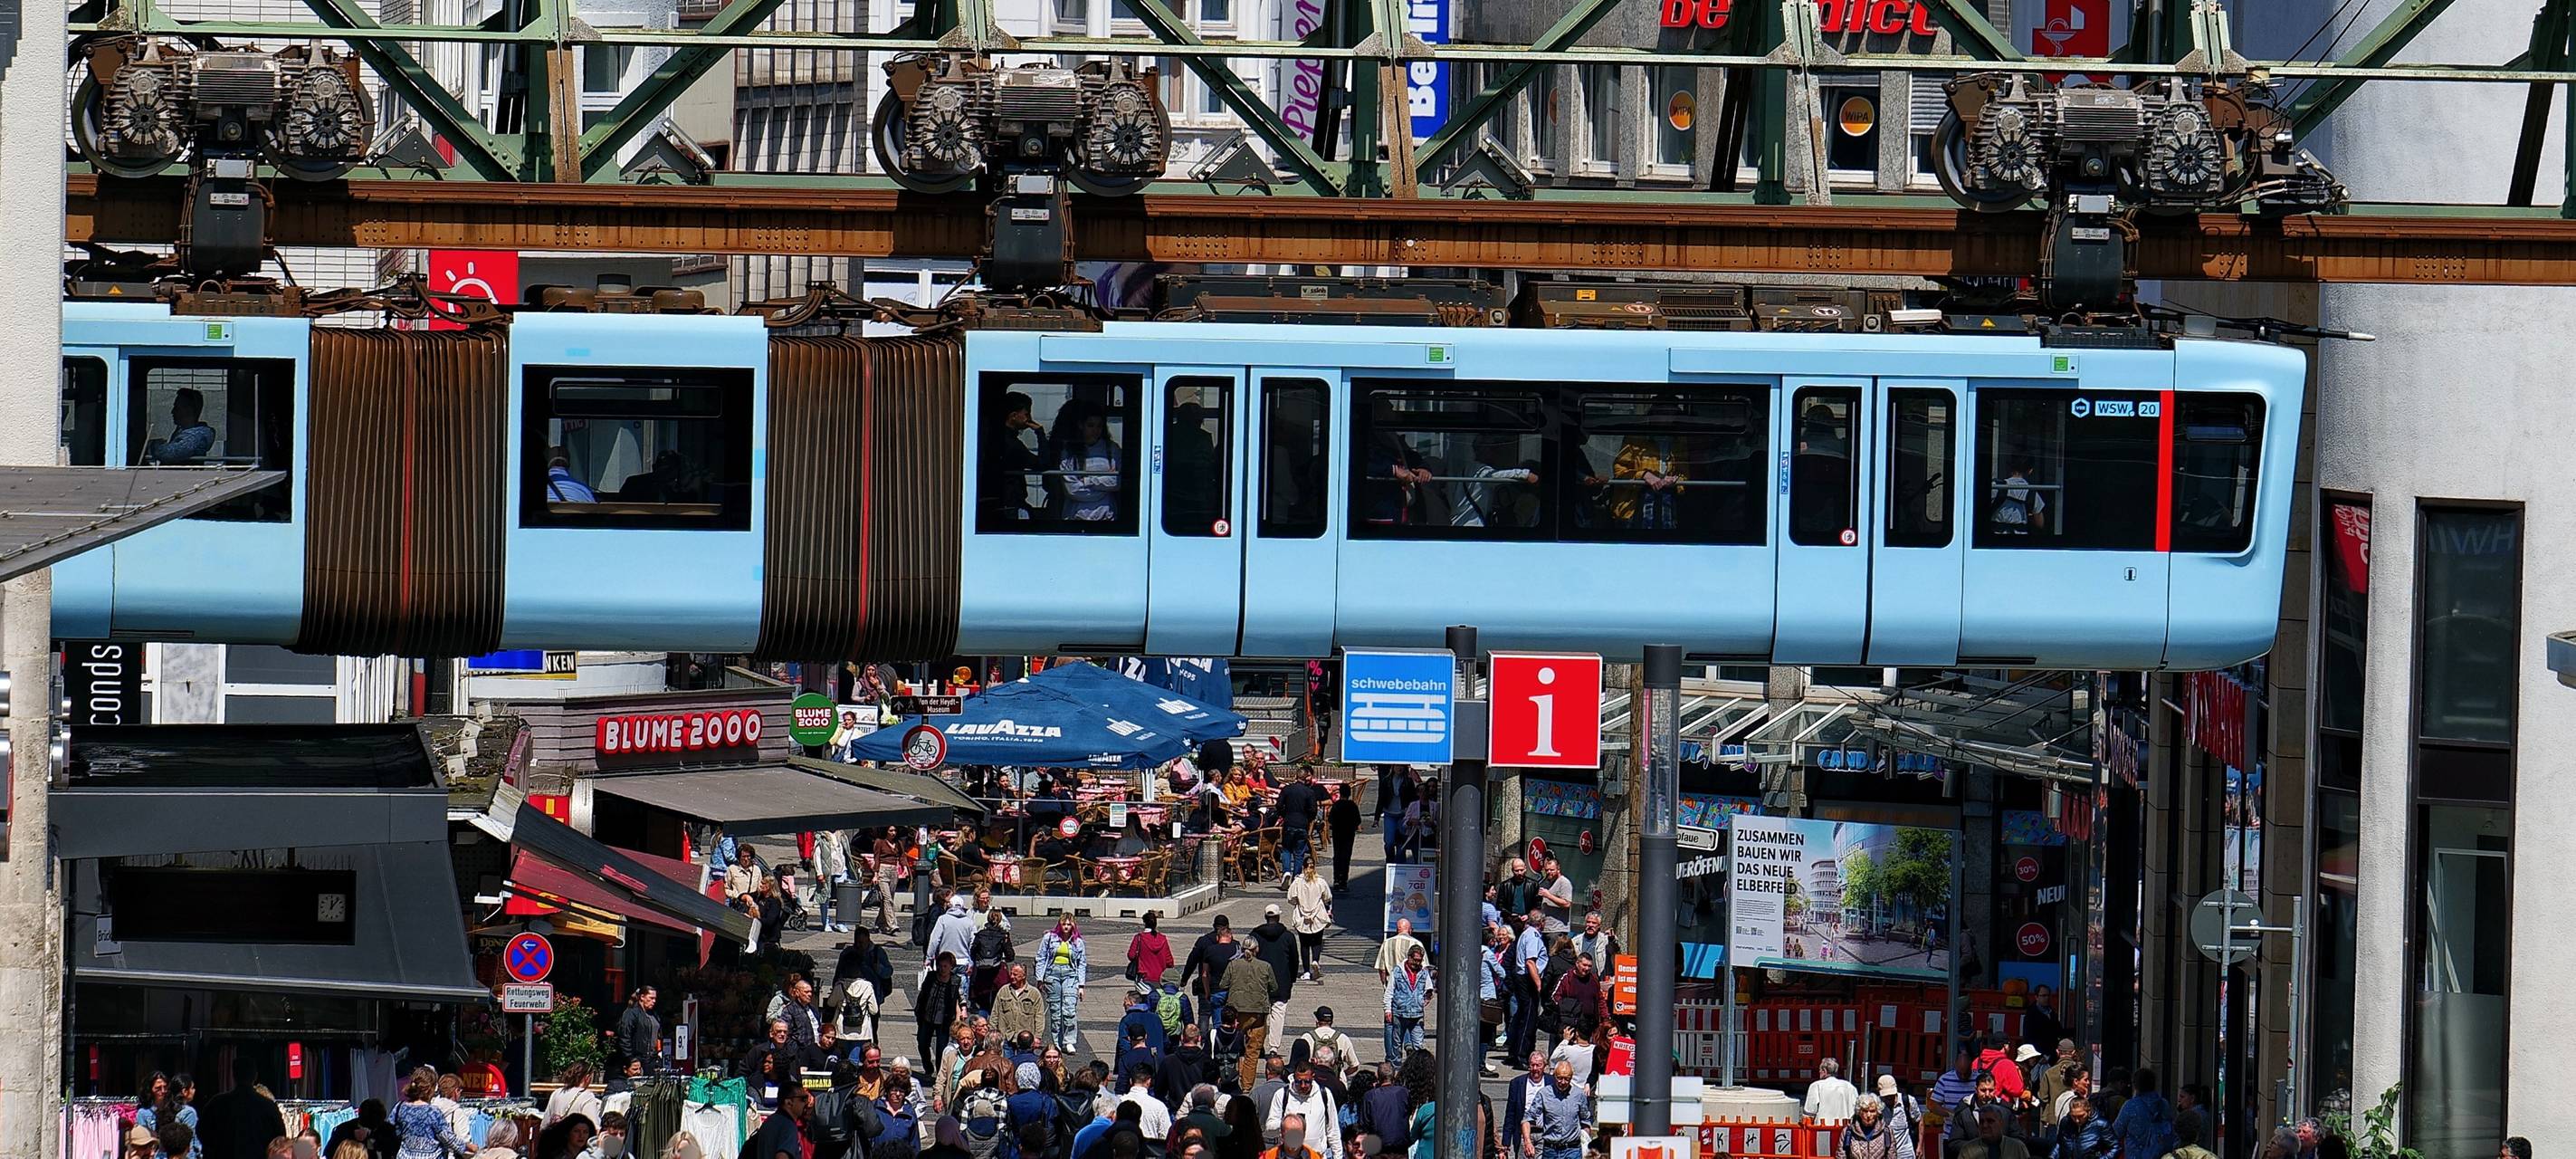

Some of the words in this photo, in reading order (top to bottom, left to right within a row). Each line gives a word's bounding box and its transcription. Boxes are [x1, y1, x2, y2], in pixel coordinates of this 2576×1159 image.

[1845, 110, 1869, 123] WIPA
[2141, 404, 2156, 415] 20
[1351, 677, 1446, 691] schwebebahn
[930, 697, 939, 705] der
[795, 707, 833, 718] BLUME
[797, 717, 830, 727] 2000
[602, 715, 685, 752] BLUME
[688, 711, 762, 749] 2000
[944, 720, 1062, 738] LAVAZZA
[1737, 829, 1805, 846] ZUSAMMEN
[1737, 846, 1776, 860] BAUEN
[1779, 848, 1802, 862] WIR
[1737, 862, 1760, 876] DAS
[1762, 864, 1794, 878] NEUE
[2018, 865, 2036, 875] 30%
[1407, 882, 1426, 890] 7GB
[1736, 878, 1798, 895] ELBERFELD
[2021, 934, 2046, 946] 50%
[507, 987, 549, 999] Rettungsweg
[510, 999, 546, 1009] Feuerwehr
[463, 1072, 493, 1089] NEU!
[802, 1078, 832, 1088] ERICANA
